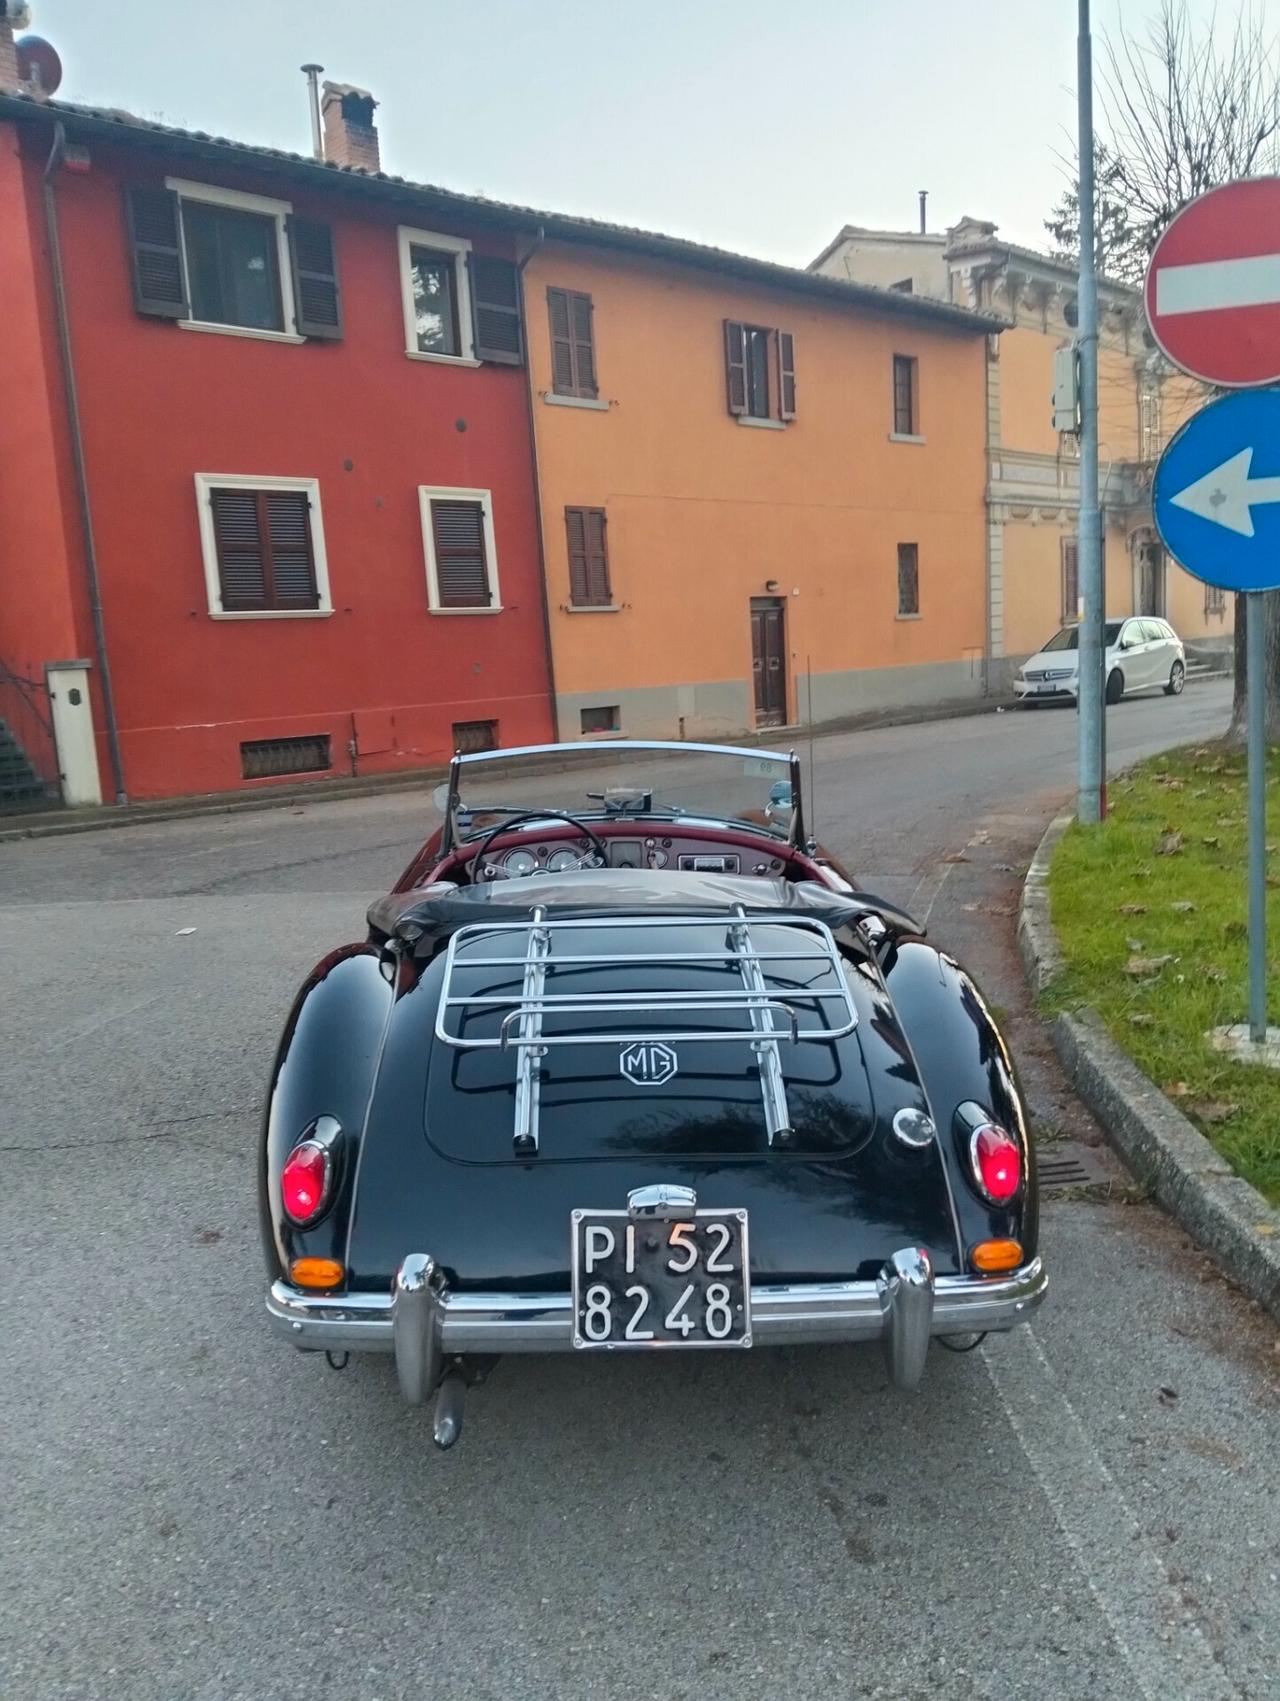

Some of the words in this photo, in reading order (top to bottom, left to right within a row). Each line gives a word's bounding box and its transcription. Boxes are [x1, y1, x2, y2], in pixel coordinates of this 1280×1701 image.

[627, 1047, 671, 1080] MG
[585, 1225, 635, 1274] PI
[668, 1223, 734, 1273] 52
[585, 1283, 732, 1341] 8248
